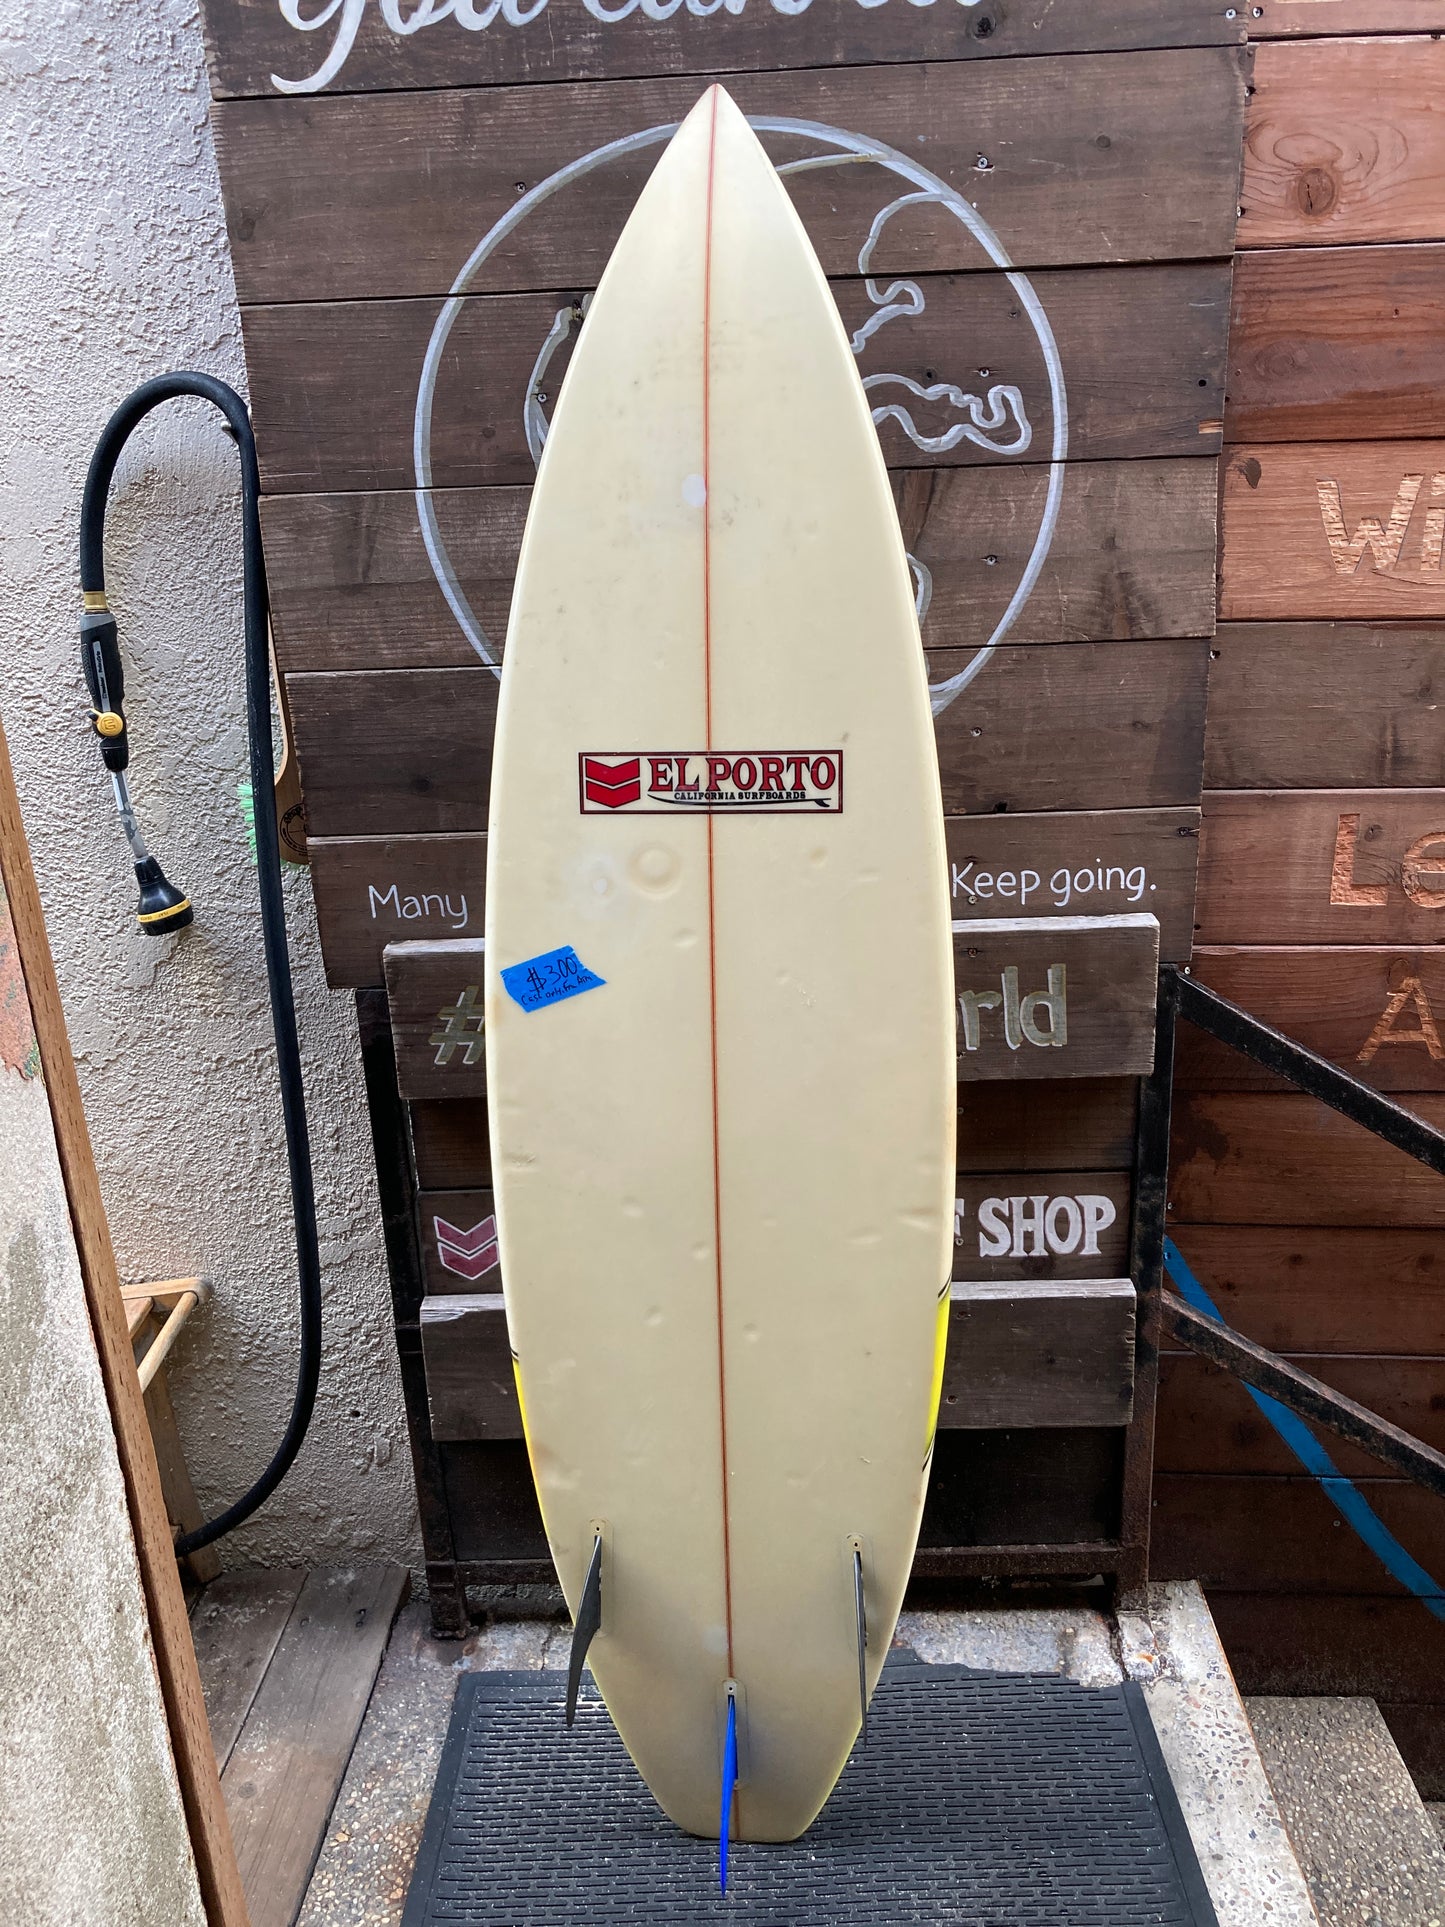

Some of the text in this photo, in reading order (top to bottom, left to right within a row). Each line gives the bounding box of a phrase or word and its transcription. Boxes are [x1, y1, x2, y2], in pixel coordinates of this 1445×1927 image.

[647, 756, 836, 792] EL PORTO
[674, 791, 806, 801] CALIFORNIA SURFBOARDS
[952, 858, 1157, 907] Keep going.
[367, 884, 469, 929] Many
[526, 957, 578, 993] $300
[979, 1195, 1117, 1258] SHOP
